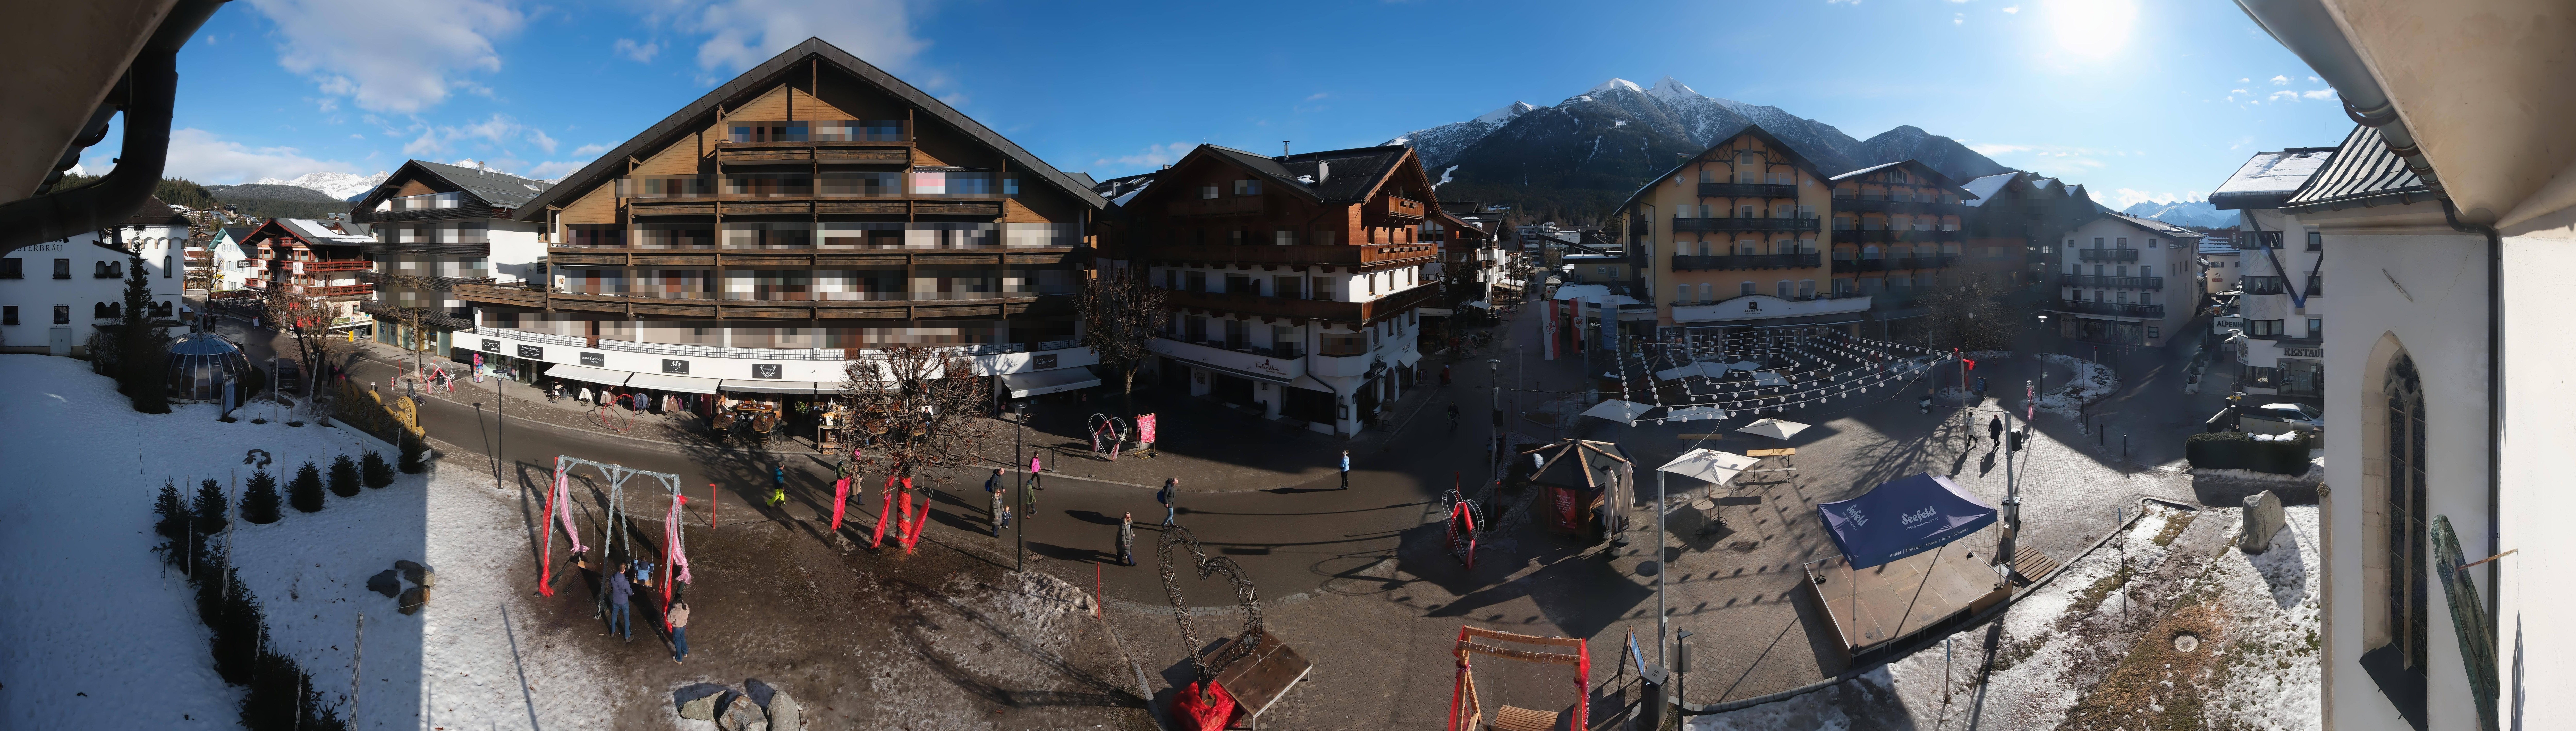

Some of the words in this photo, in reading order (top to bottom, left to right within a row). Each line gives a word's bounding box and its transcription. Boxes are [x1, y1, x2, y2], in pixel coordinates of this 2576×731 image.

[671, 361, 682, 370] My
[1372, 364, 1386, 377] RESTAURANT
[1846, 504, 1868, 527] Seefeld
[1902, 505, 1936, 525] Seefeld
[1917, 517, 1939, 527] HOCHPLATEAU
[1954, 528, 1968, 536] Scharnitz
